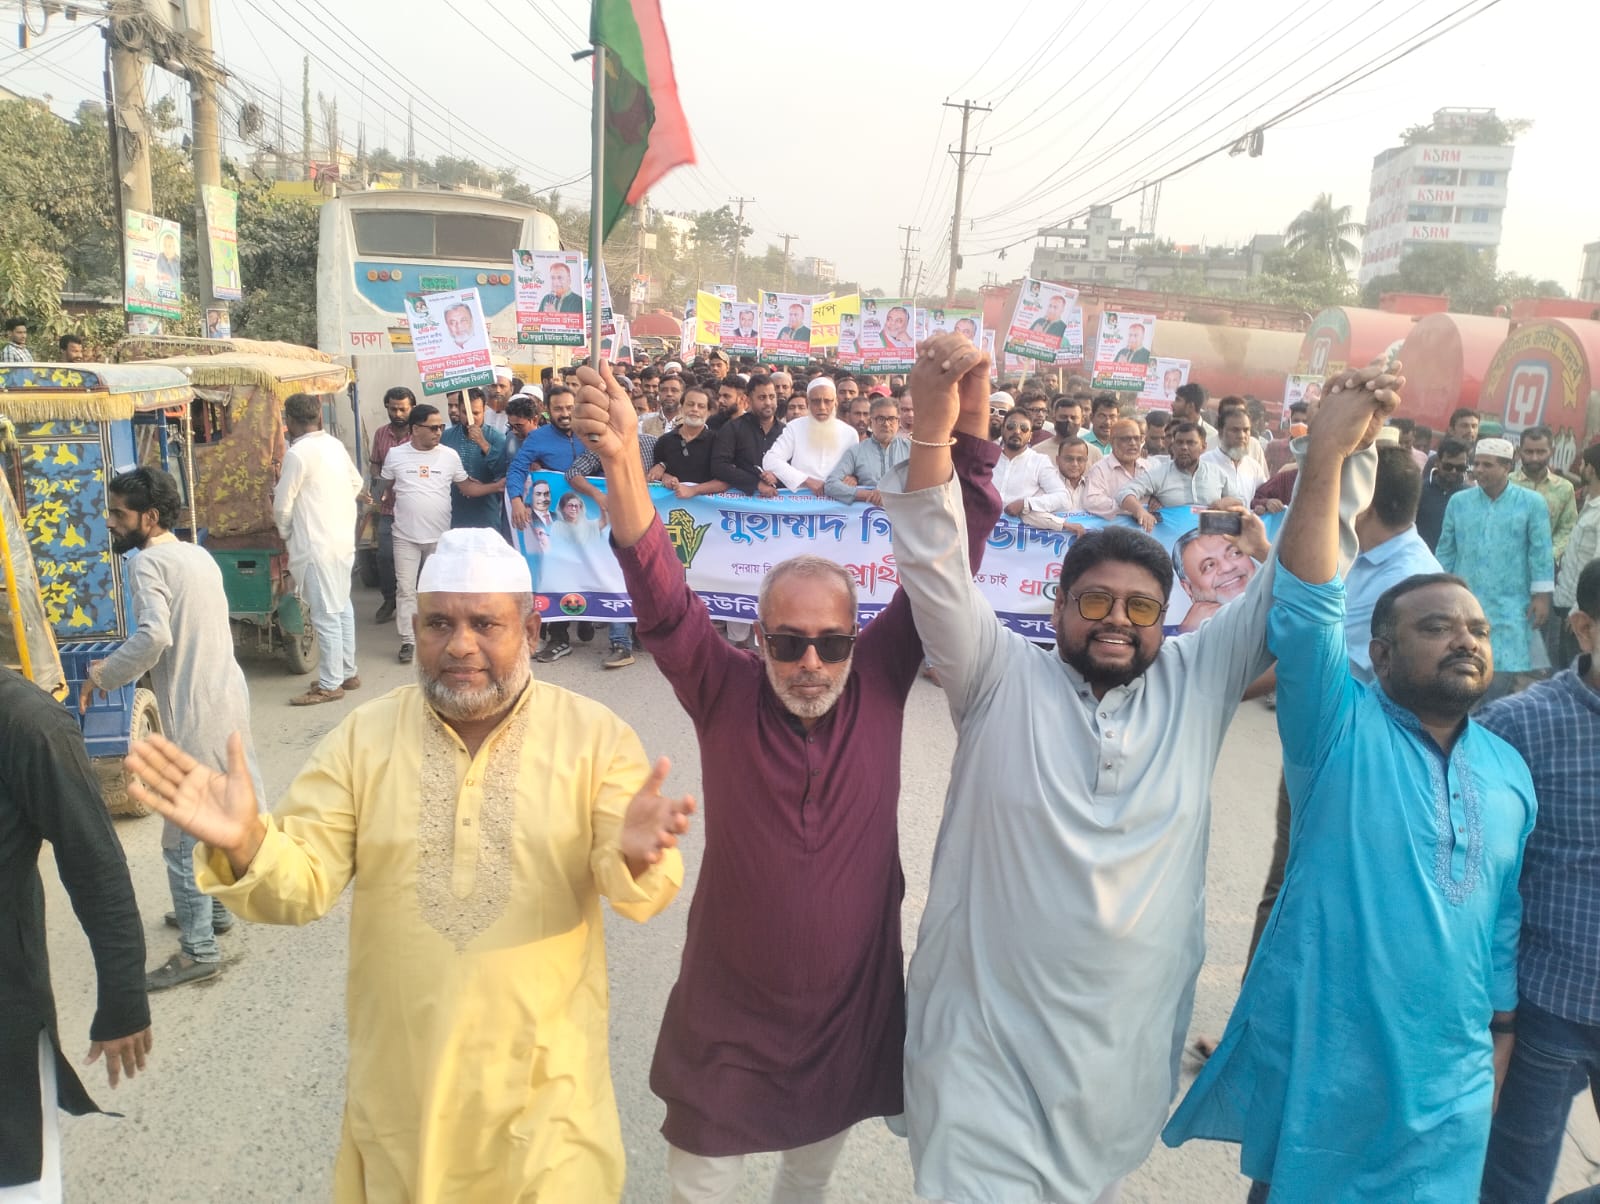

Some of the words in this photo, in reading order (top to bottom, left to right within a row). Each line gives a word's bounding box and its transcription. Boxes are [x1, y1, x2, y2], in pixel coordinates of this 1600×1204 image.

[1423, 149, 1462, 162] KSRM
[1417, 189, 1455, 202] KSRM
[1412, 226, 1449, 240] KSRM
[349, 331, 385, 350] ঢাকা
[718, 509, 848, 545] মুহাম্মদ
[989, 572, 1009, 588] চাই
